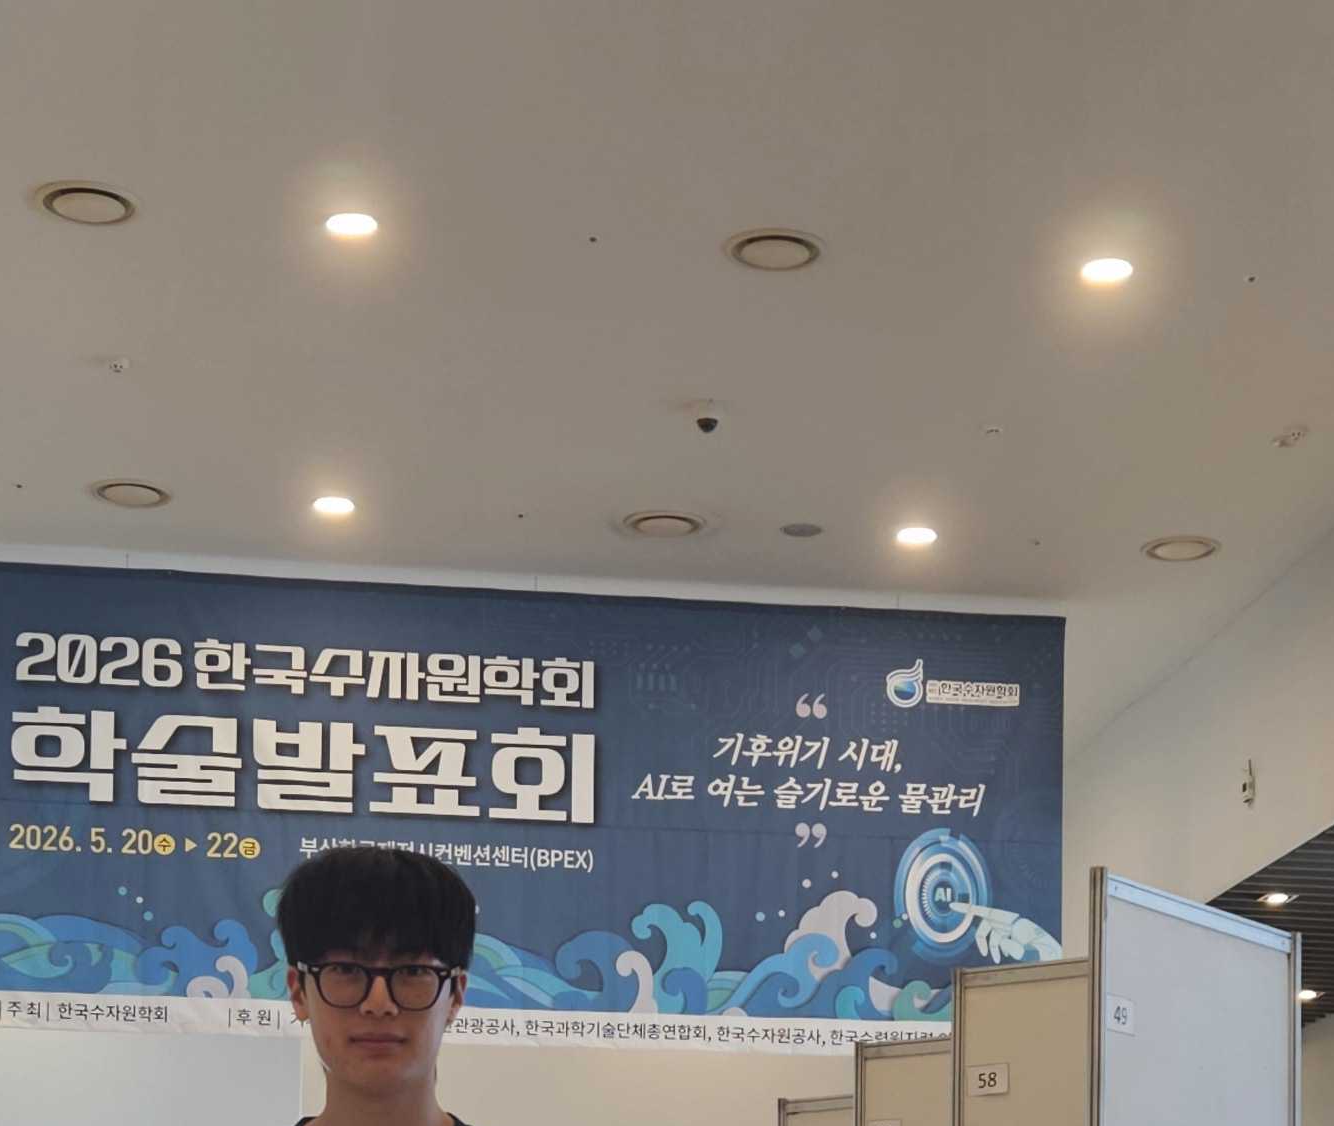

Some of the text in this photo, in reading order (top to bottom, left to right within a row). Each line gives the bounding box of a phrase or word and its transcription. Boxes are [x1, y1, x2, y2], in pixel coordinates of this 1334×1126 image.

[15, 631, 595, 709] 2026 한국수자원학회
[11, 706, 595, 823] 학술발표회
[713, 733, 902, 773] 기후위기 시대,
[631, 773, 986, 817] AI로 여는 슬기로운 물관리
[9, 824, 81, 852] 2026.
[90, 828, 112, 853] 5.
[934, 887, 952, 902] AI
[58, 1002, 168, 1023] 한국수자원학회
[1113, 1005, 1128, 1025] 49
[443, 1018, 520, 1037] 관광공사,
[525, 1020, 712, 1043] 한국과학기술단체총연합회,
[717, 1024, 826, 1047] 한국수자원공사,
[978, 1072, 997, 1089] 58
